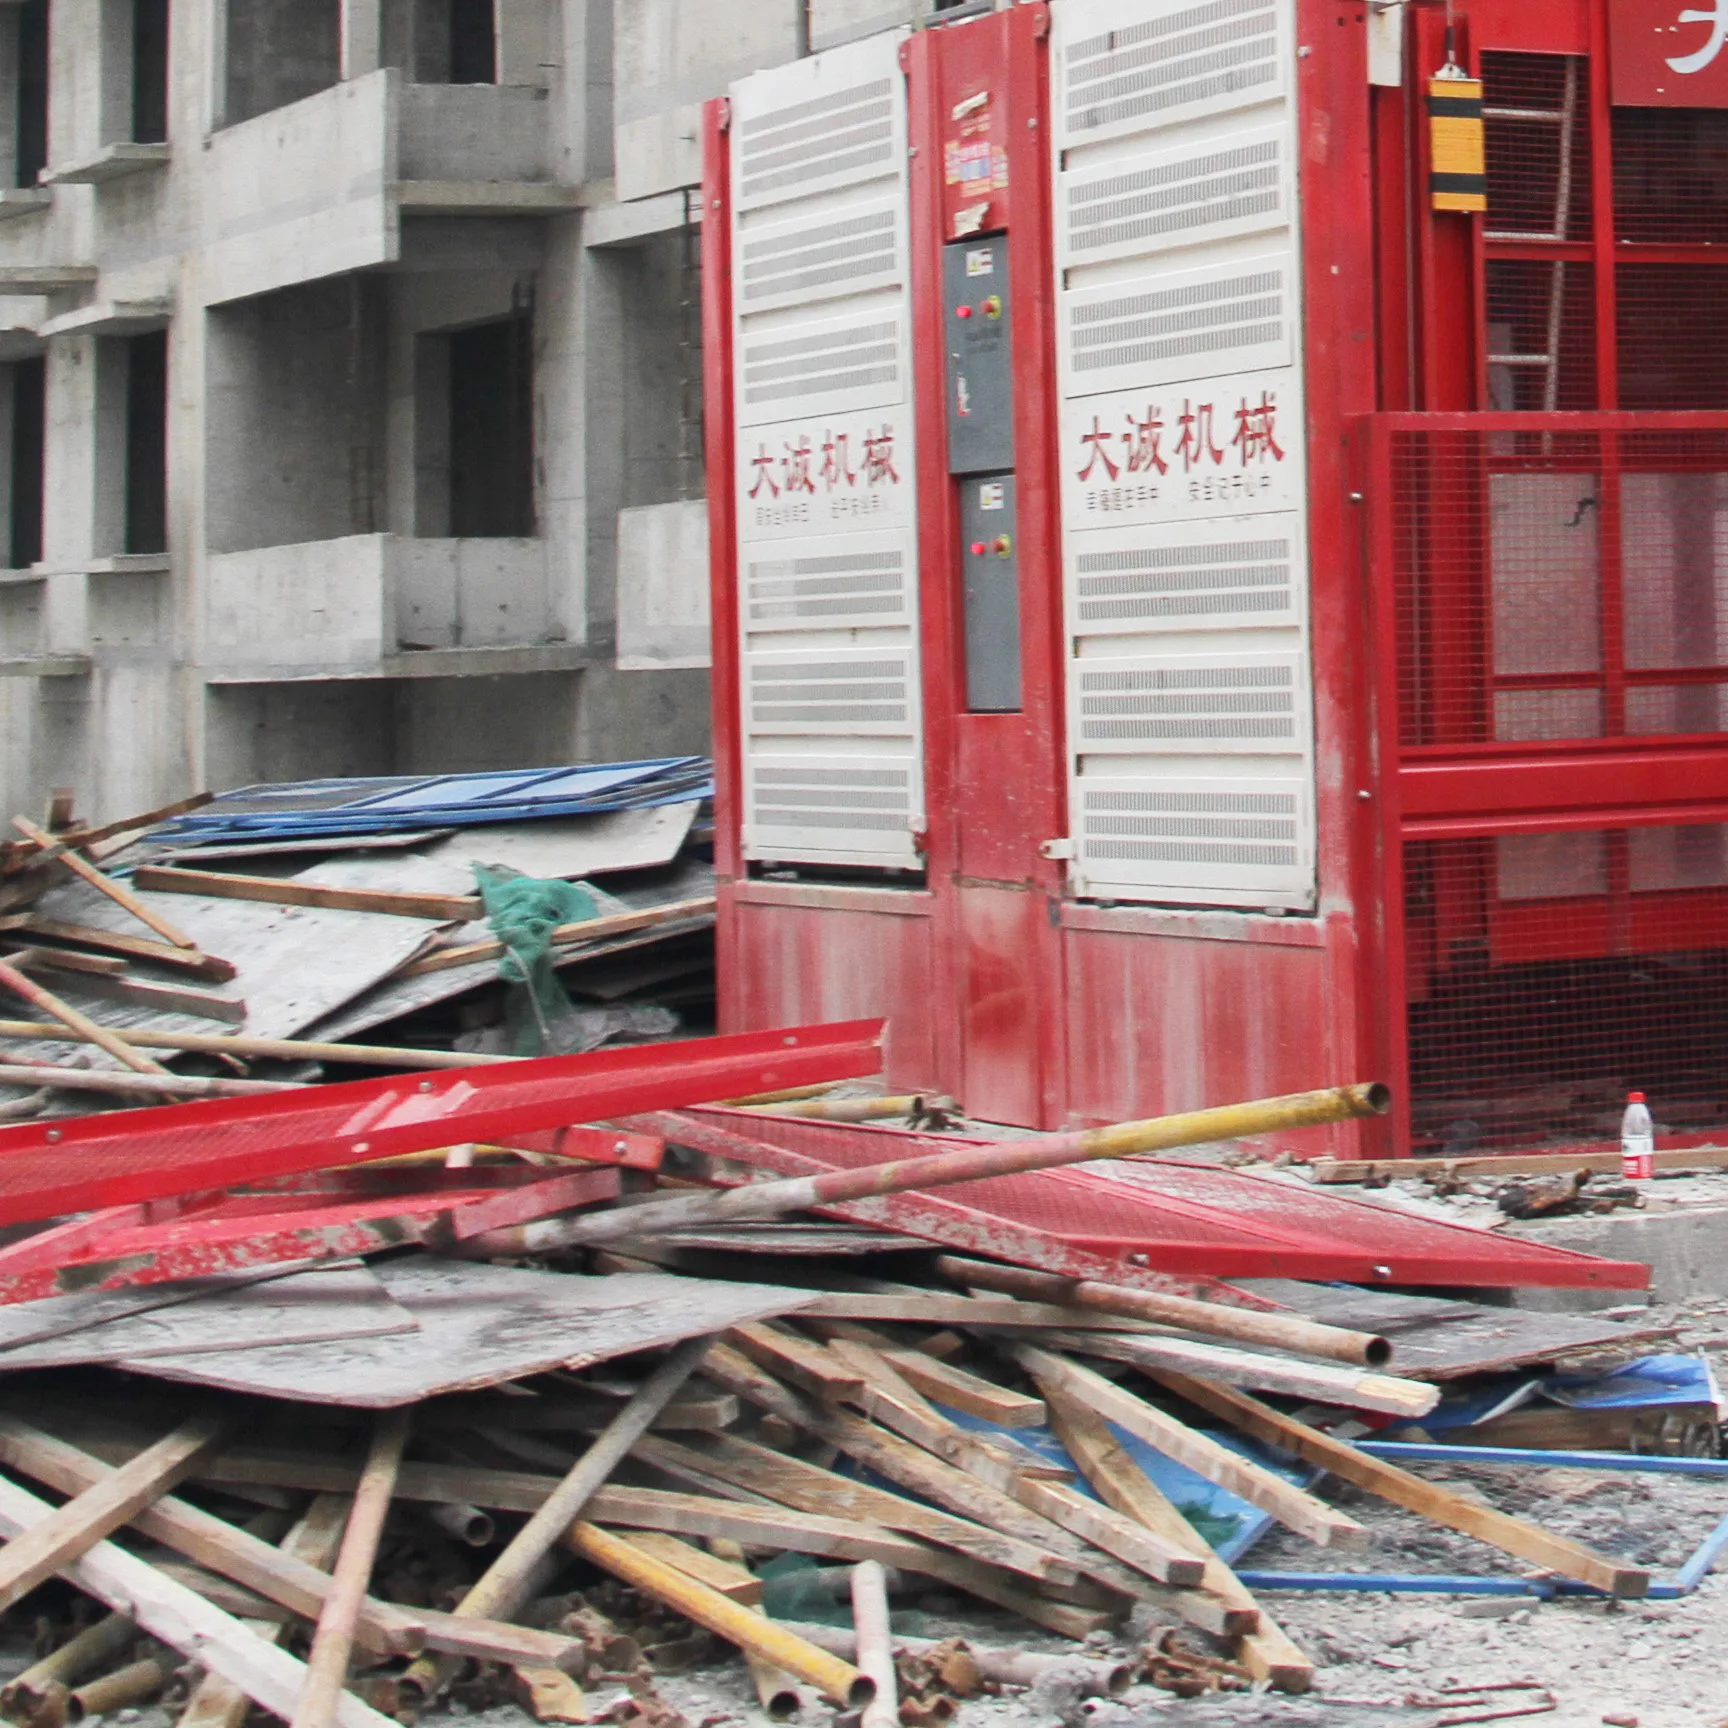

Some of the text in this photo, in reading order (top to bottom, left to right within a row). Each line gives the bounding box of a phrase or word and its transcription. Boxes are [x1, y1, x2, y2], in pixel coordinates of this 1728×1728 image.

[748, 423, 900, 500] 大诚机械
[1077, 389, 1286, 482] 大诚机械
